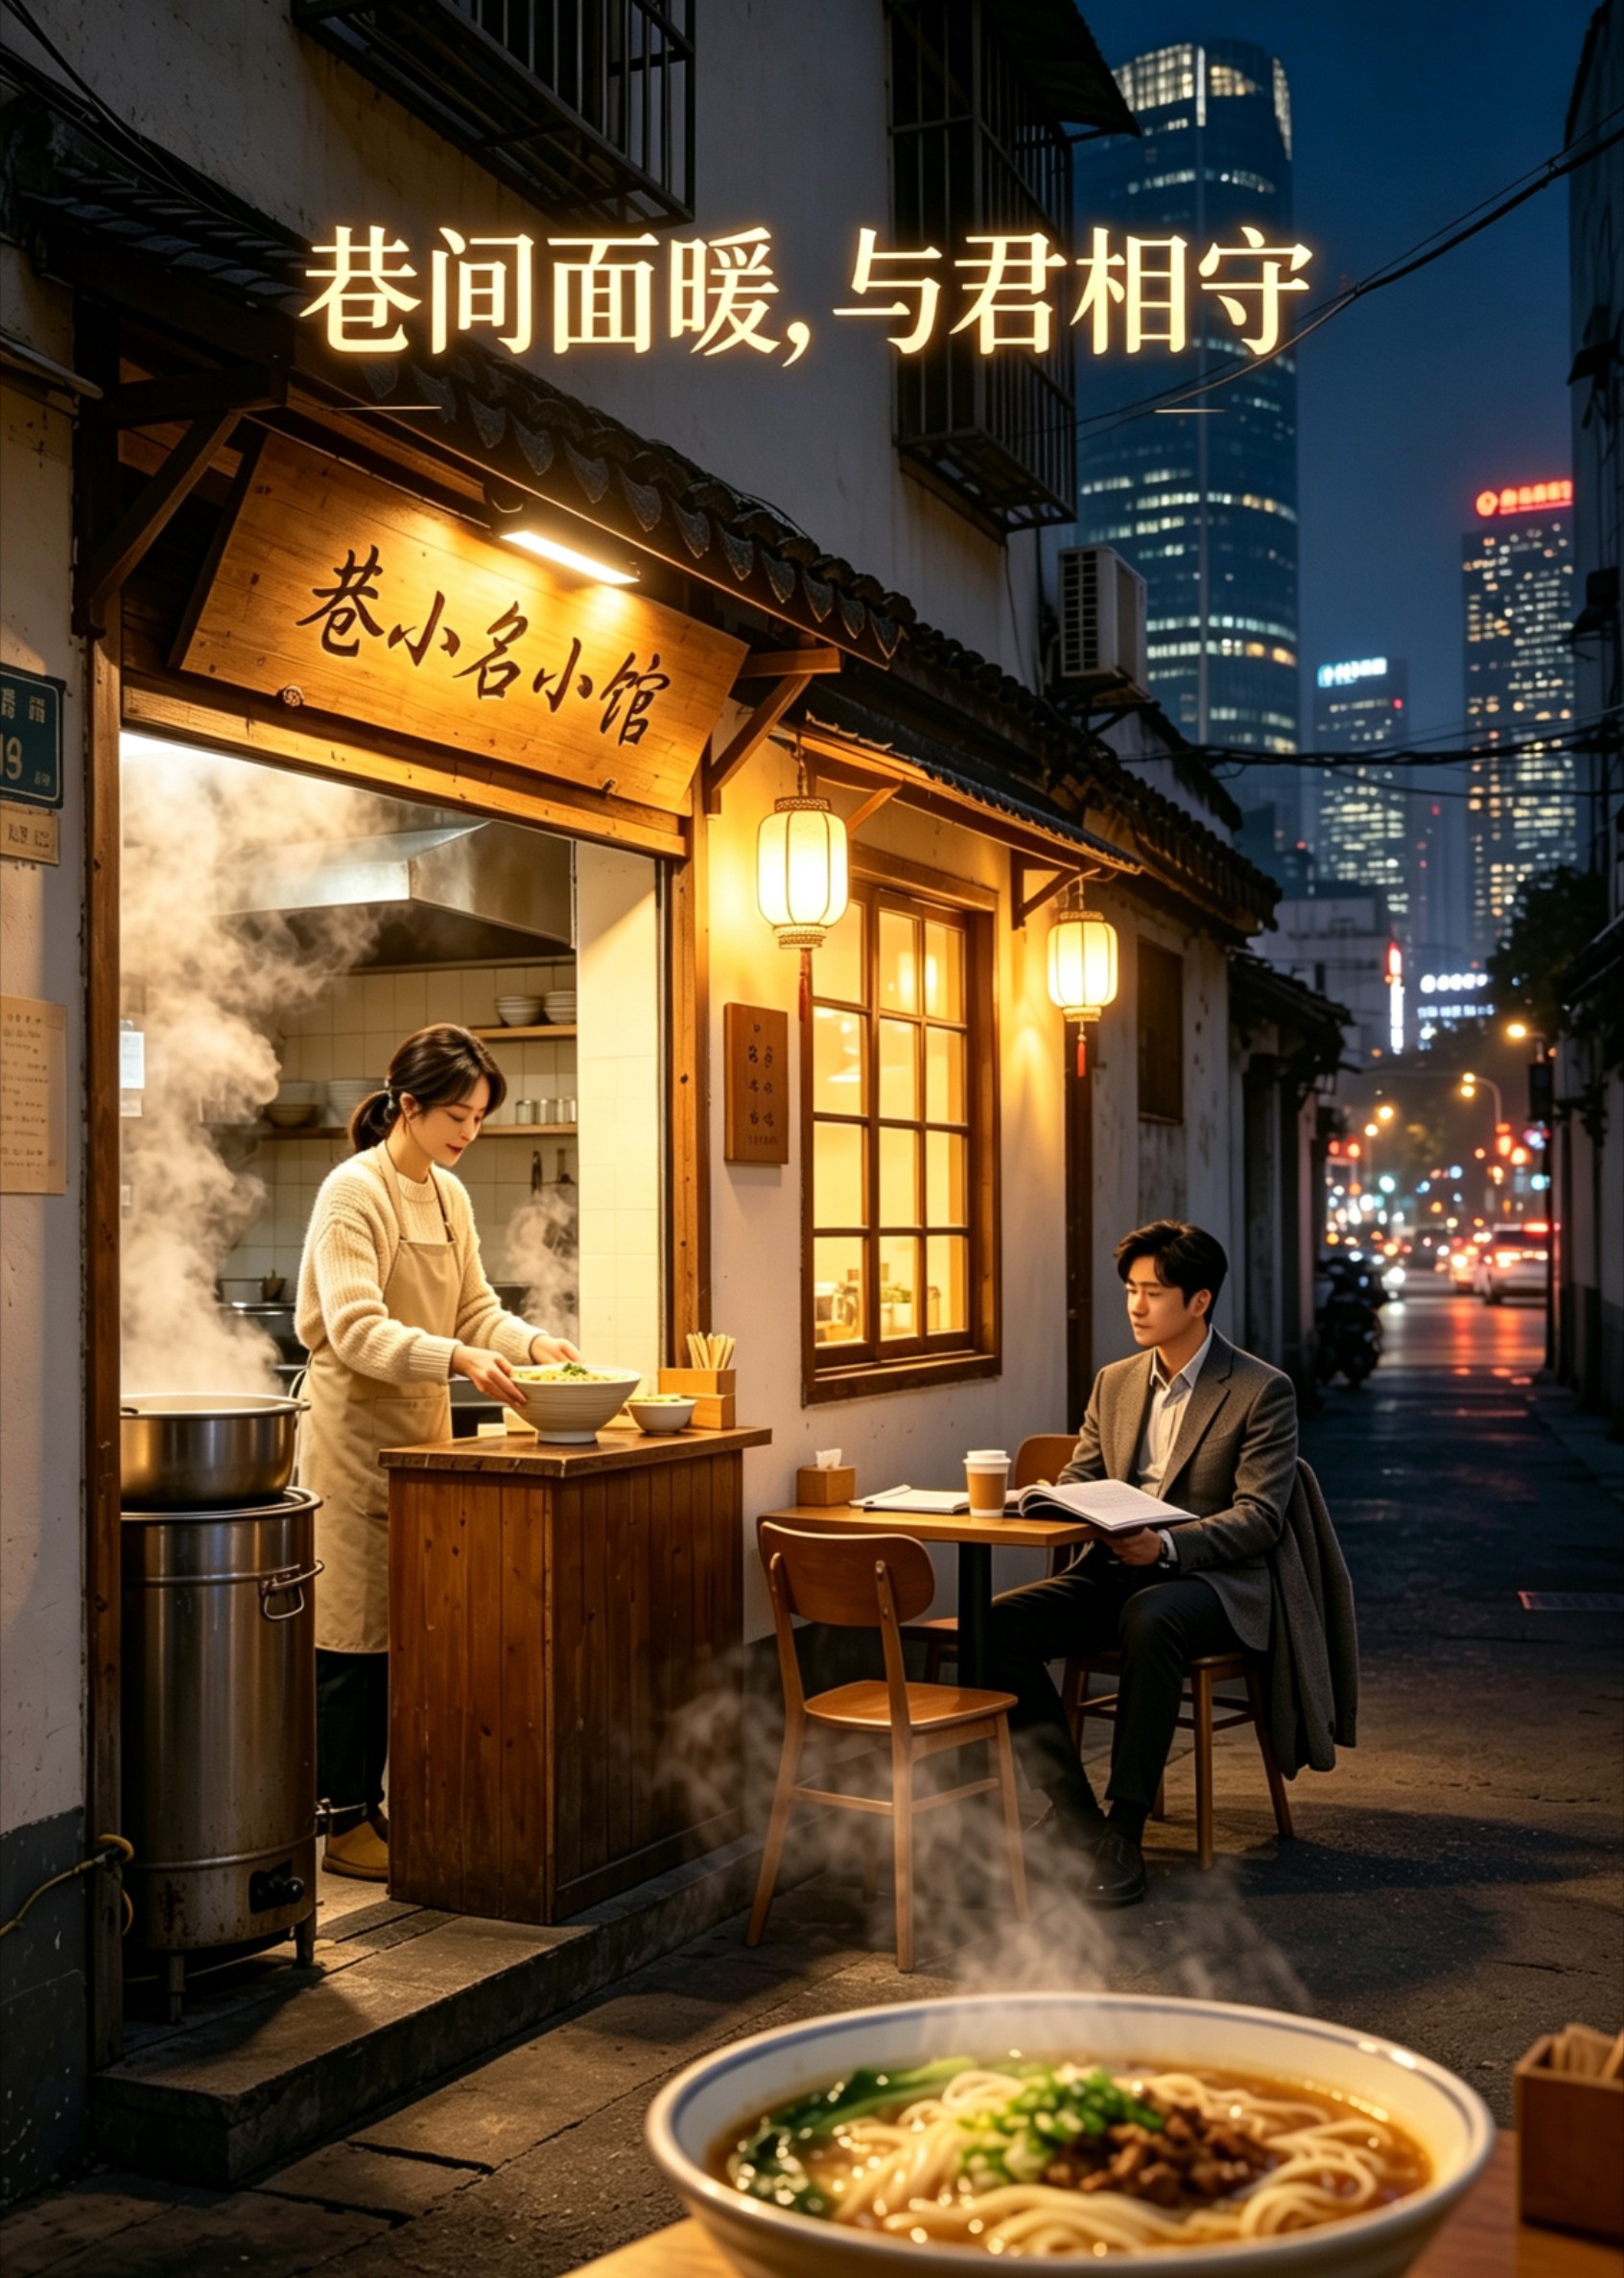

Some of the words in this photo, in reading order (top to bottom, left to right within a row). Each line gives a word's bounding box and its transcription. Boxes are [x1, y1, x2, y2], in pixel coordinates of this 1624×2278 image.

[295, 544, 671, 746] 巷小名小馆
